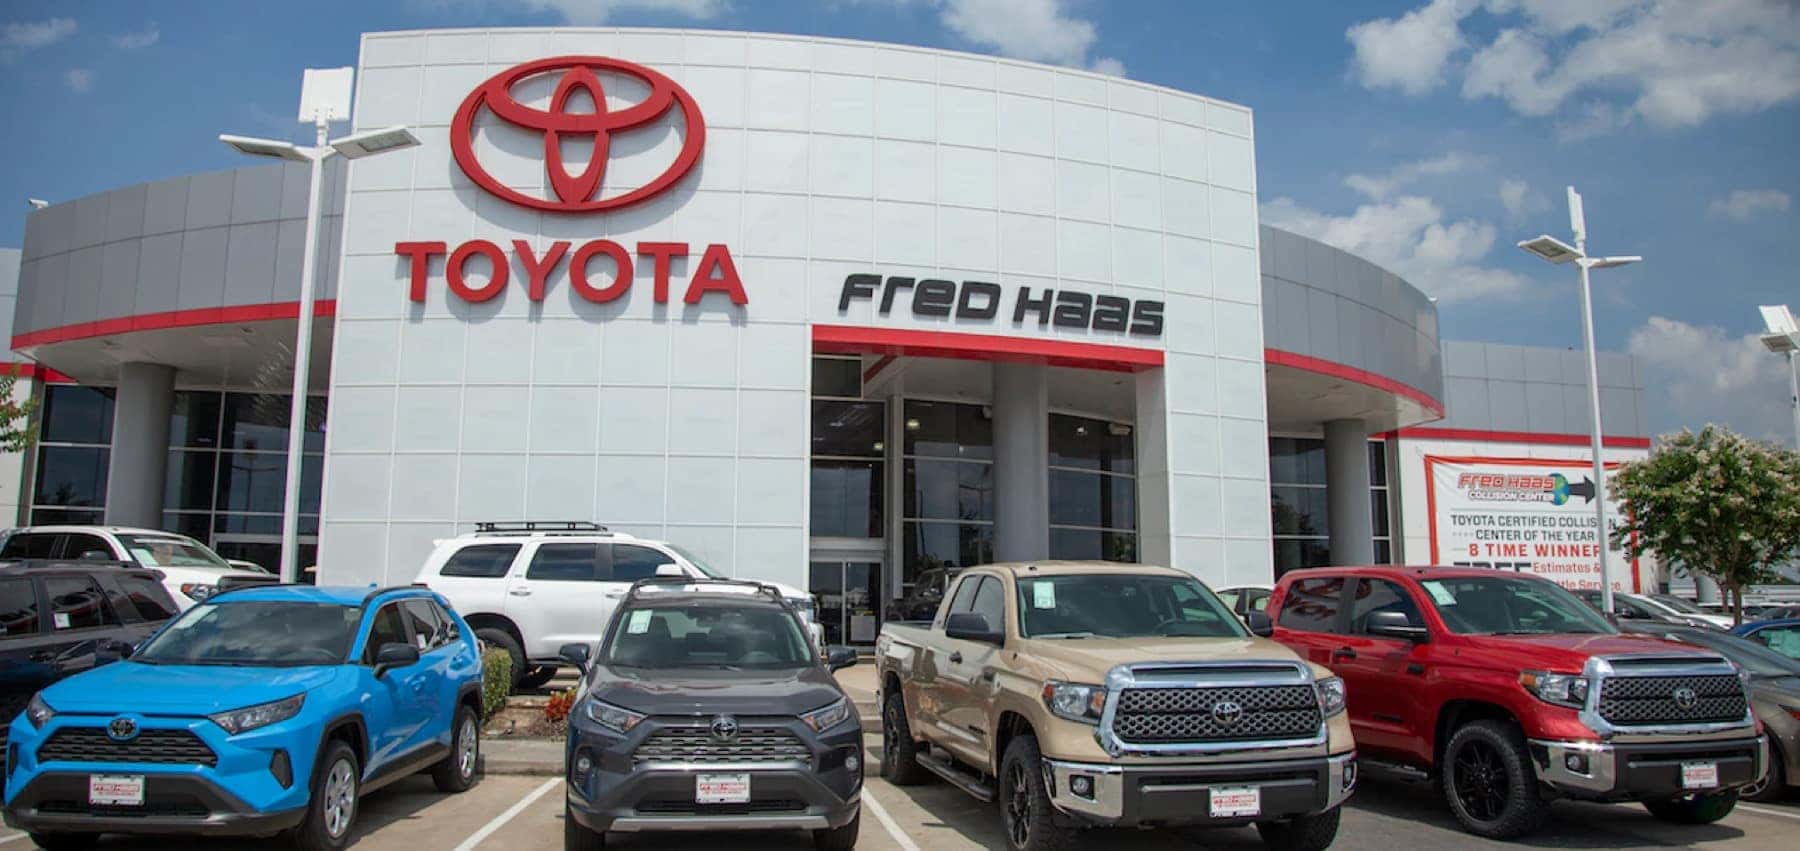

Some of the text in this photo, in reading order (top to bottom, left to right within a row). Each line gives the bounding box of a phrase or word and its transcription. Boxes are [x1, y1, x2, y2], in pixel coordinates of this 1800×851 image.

[395, 239, 749, 305] TOYOTA
[1451, 515, 1617, 530] TOYOTA CERTIFIED COLLISN
[1476, 530, 1595, 541] CENTER OF THE YEAR
[1469, 543, 1479, 557] 8
[1485, 543, 1528, 557] TIME
[1533, 562, 1591, 573] Estimates
